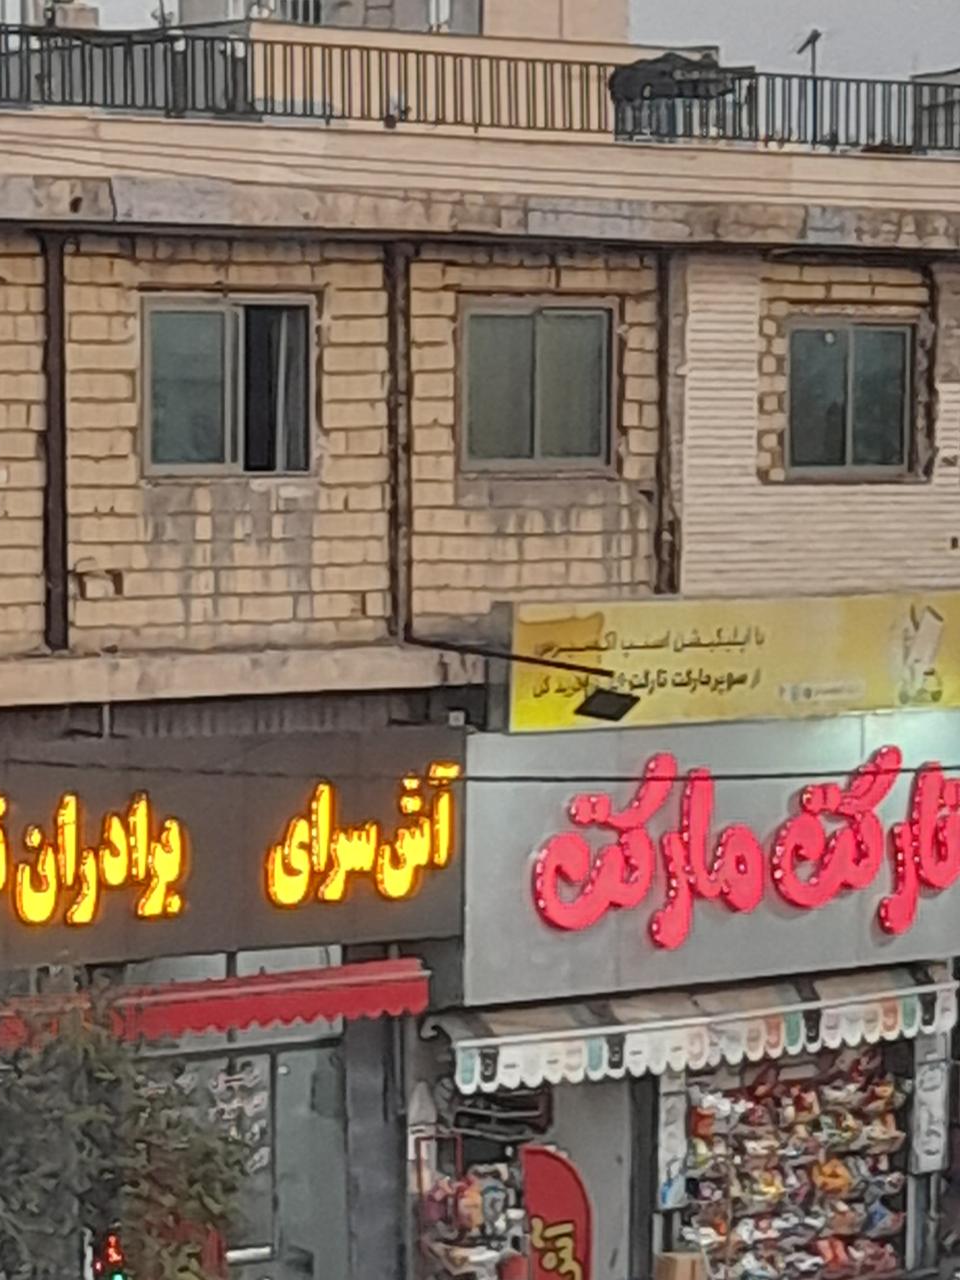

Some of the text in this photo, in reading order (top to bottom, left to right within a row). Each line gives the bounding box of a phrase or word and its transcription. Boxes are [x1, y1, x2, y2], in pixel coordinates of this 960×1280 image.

[16, 791, 183, 926] برادران
[267, 779, 378, 906] سرای
[376, 763, 461, 899] آش
[531, 752, 765, 952] مارکت
